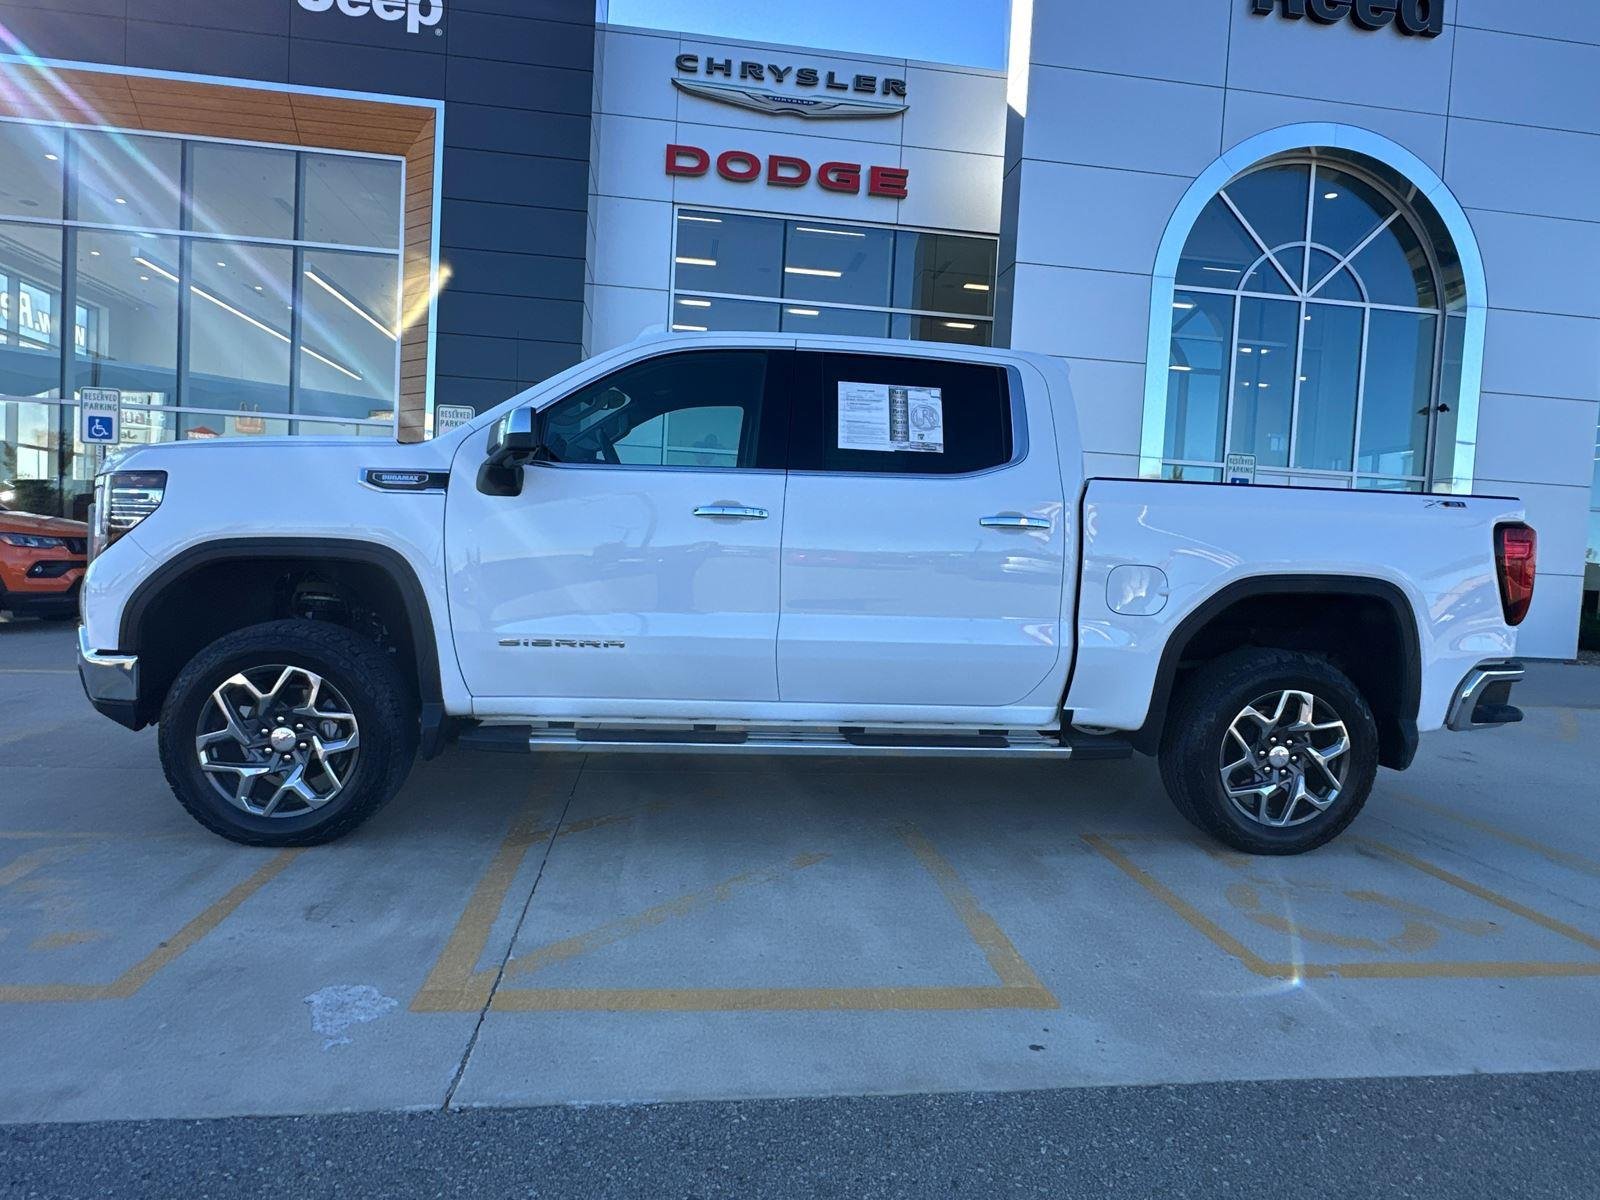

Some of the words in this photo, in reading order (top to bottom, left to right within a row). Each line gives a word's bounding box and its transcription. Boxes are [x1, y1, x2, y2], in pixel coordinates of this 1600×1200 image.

[1252, 0, 1443, 38] eed
[675, 54, 908, 98] CHRYSLER
[665, 143, 909, 199] DODGE
[84, 392, 118, 402] RESERVED
[84, 402, 118, 412] PARKING
[440, 410, 471, 419] RESERVED
[1229, 466, 1254, 474] PARKING
[499, 638, 625, 648] SIERRA
